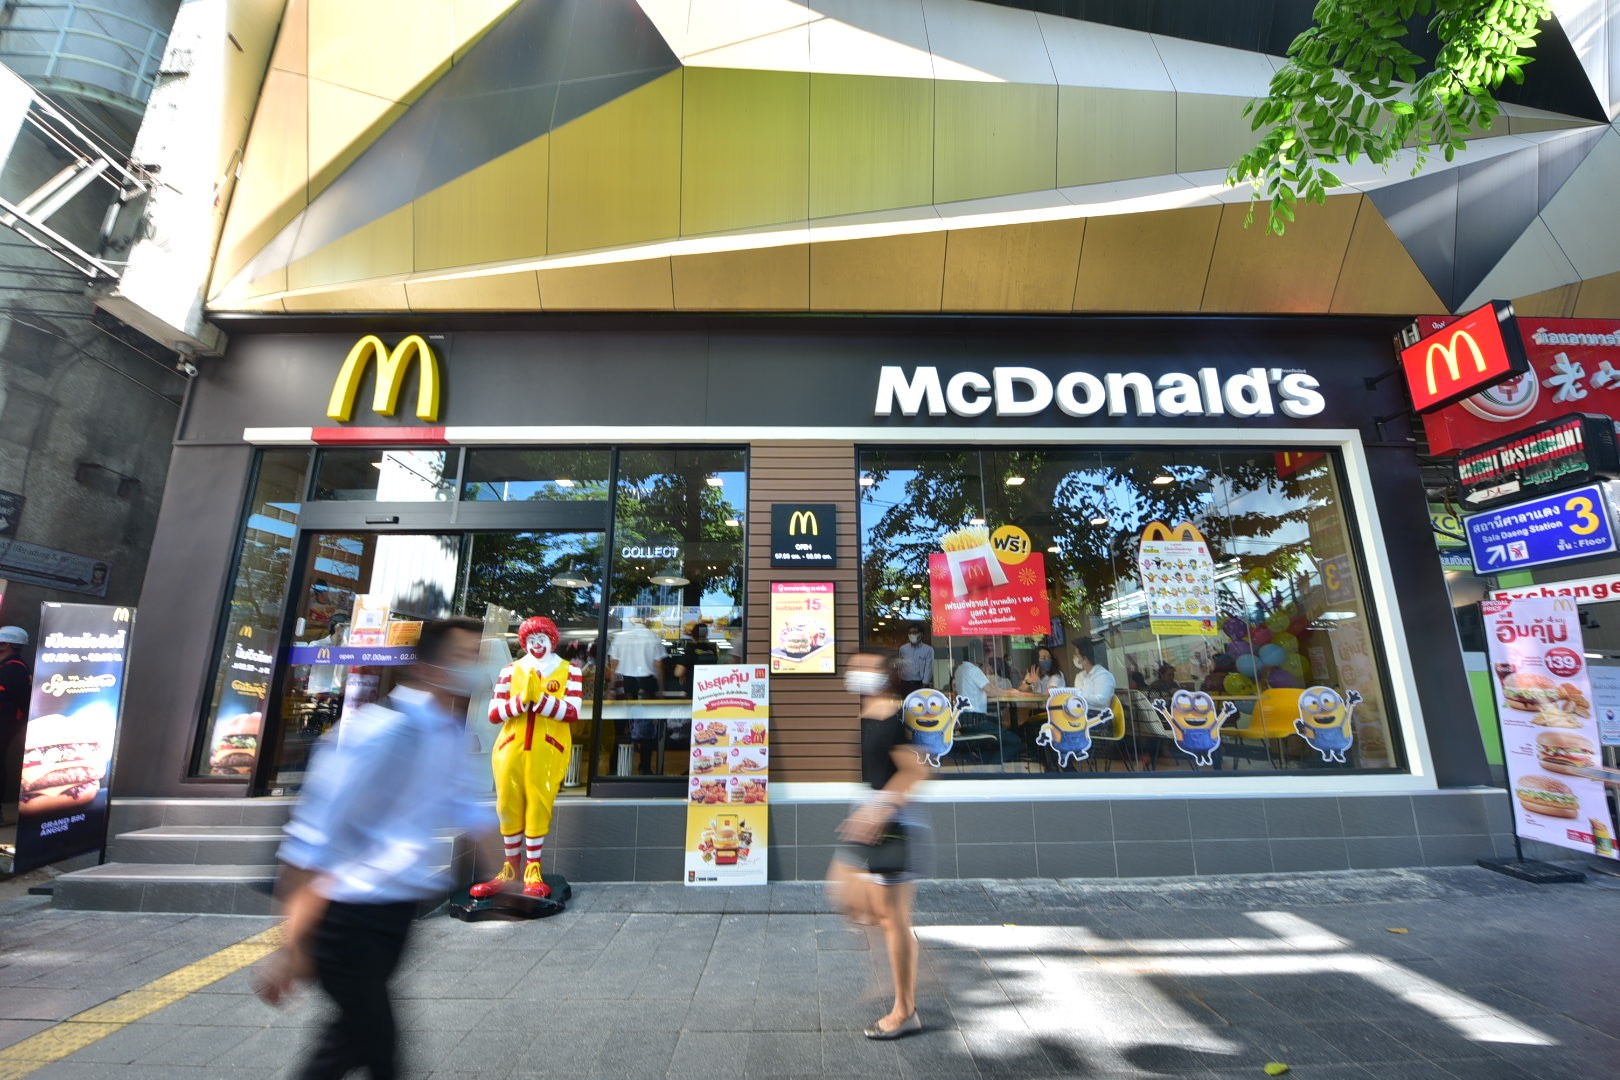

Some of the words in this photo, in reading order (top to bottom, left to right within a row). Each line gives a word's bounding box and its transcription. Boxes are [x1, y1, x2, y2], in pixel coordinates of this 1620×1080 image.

[874, 365, 1325, 418] McDonald's
[1472, 505, 1561, 534] สถานีศาลาแดง
[1565, 496, 1600, 536] 3
[1482, 534, 1499, 544] Sala
[1500, 528, 1529, 542] Daeng
[1529, 520, 1563, 535] Station
[621, 546, 679, 559] COLLECT
[993, 534, 1027, 554] ฟรี!
[1578, 537, 1606, 548] Floor
[804, 598, 822, 611] 15
[1545, 655, 1577, 669] 139
[697, 669, 750, 692] โปรสุดคุ้ม
[41, 817, 70, 830] GRAND
